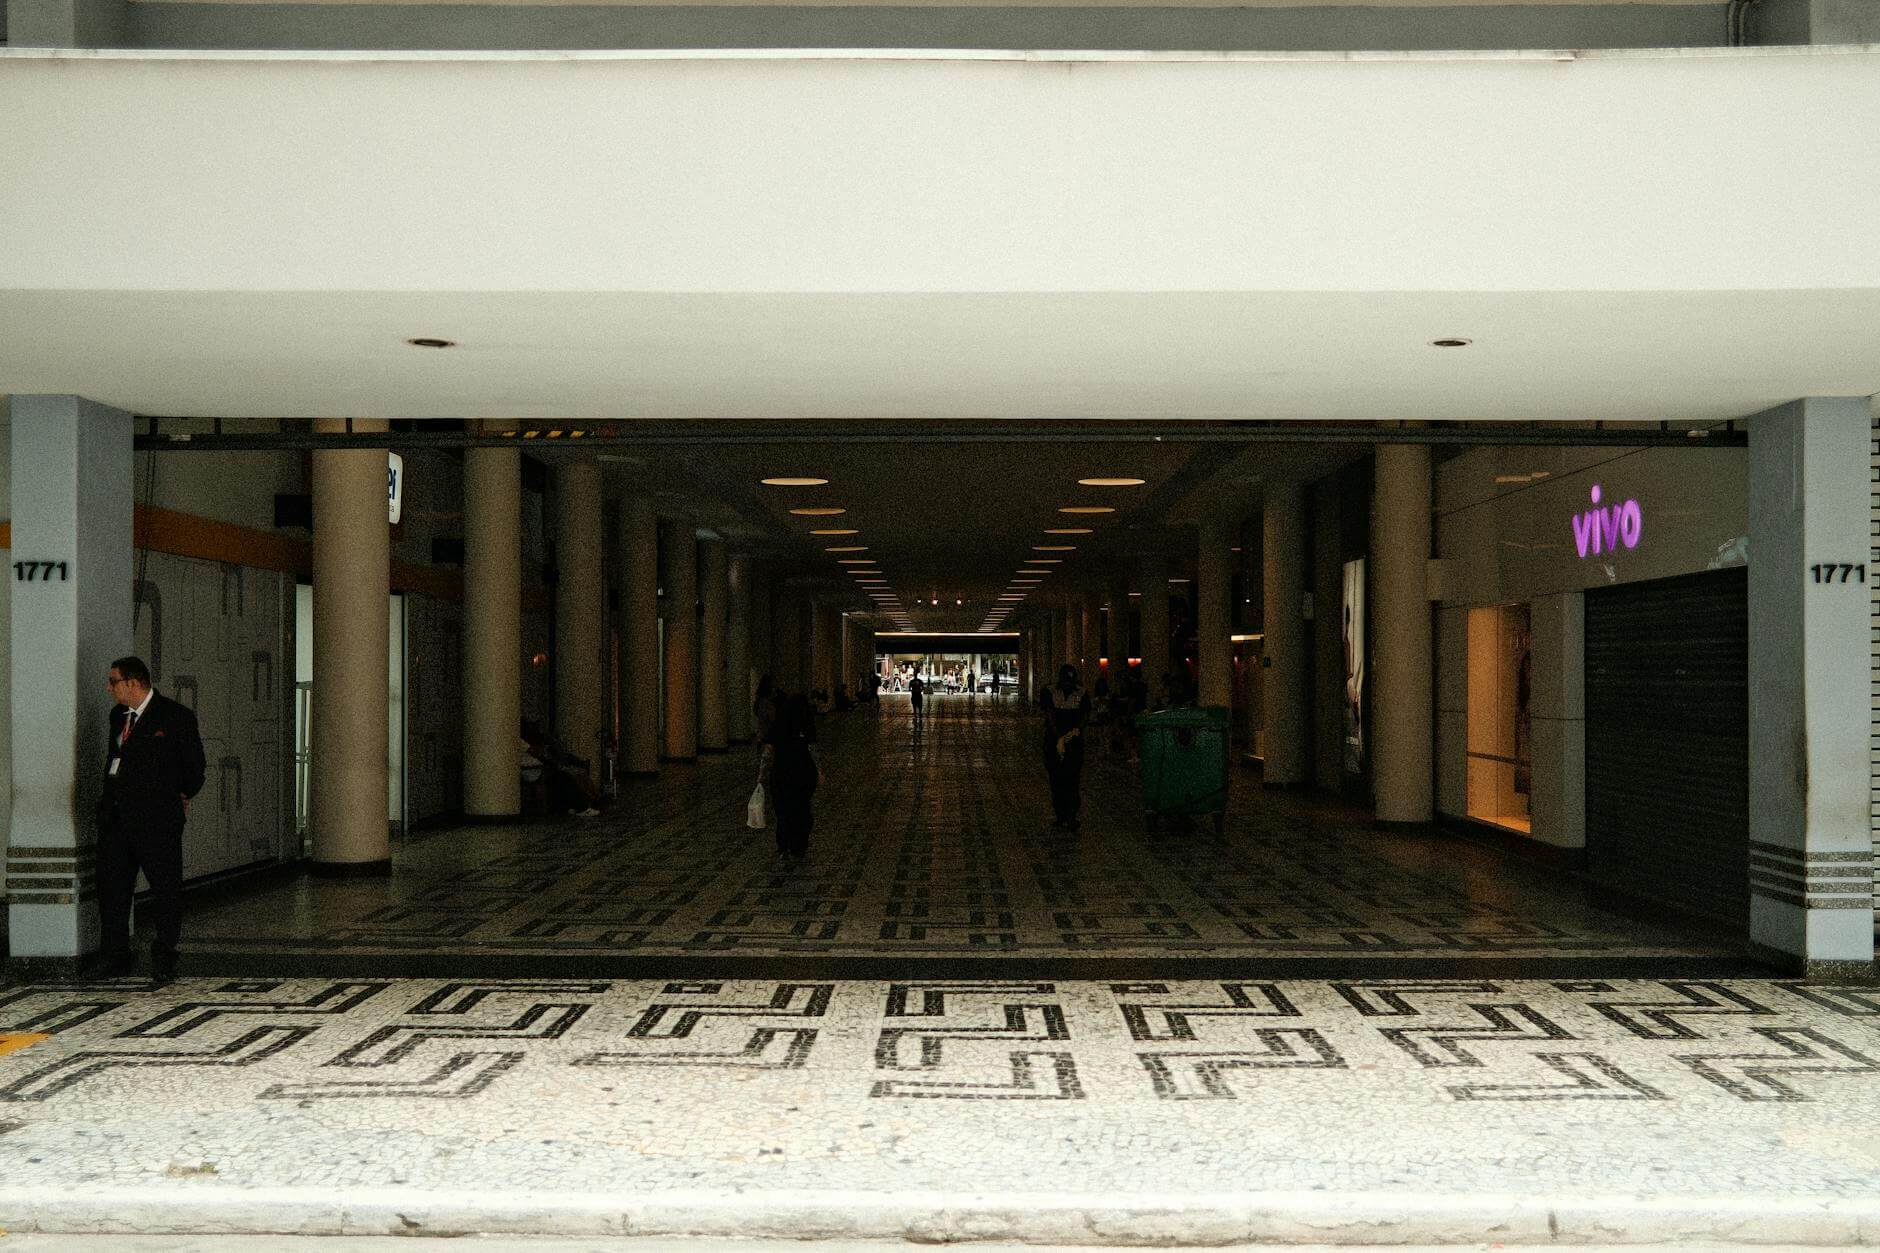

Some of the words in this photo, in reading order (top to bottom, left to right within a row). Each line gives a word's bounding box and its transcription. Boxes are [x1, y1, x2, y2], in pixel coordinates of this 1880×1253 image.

[1572, 484, 1642, 558] vivo
[13, 561, 67, 581] 1771
[1811, 564, 1865, 583] 1771
